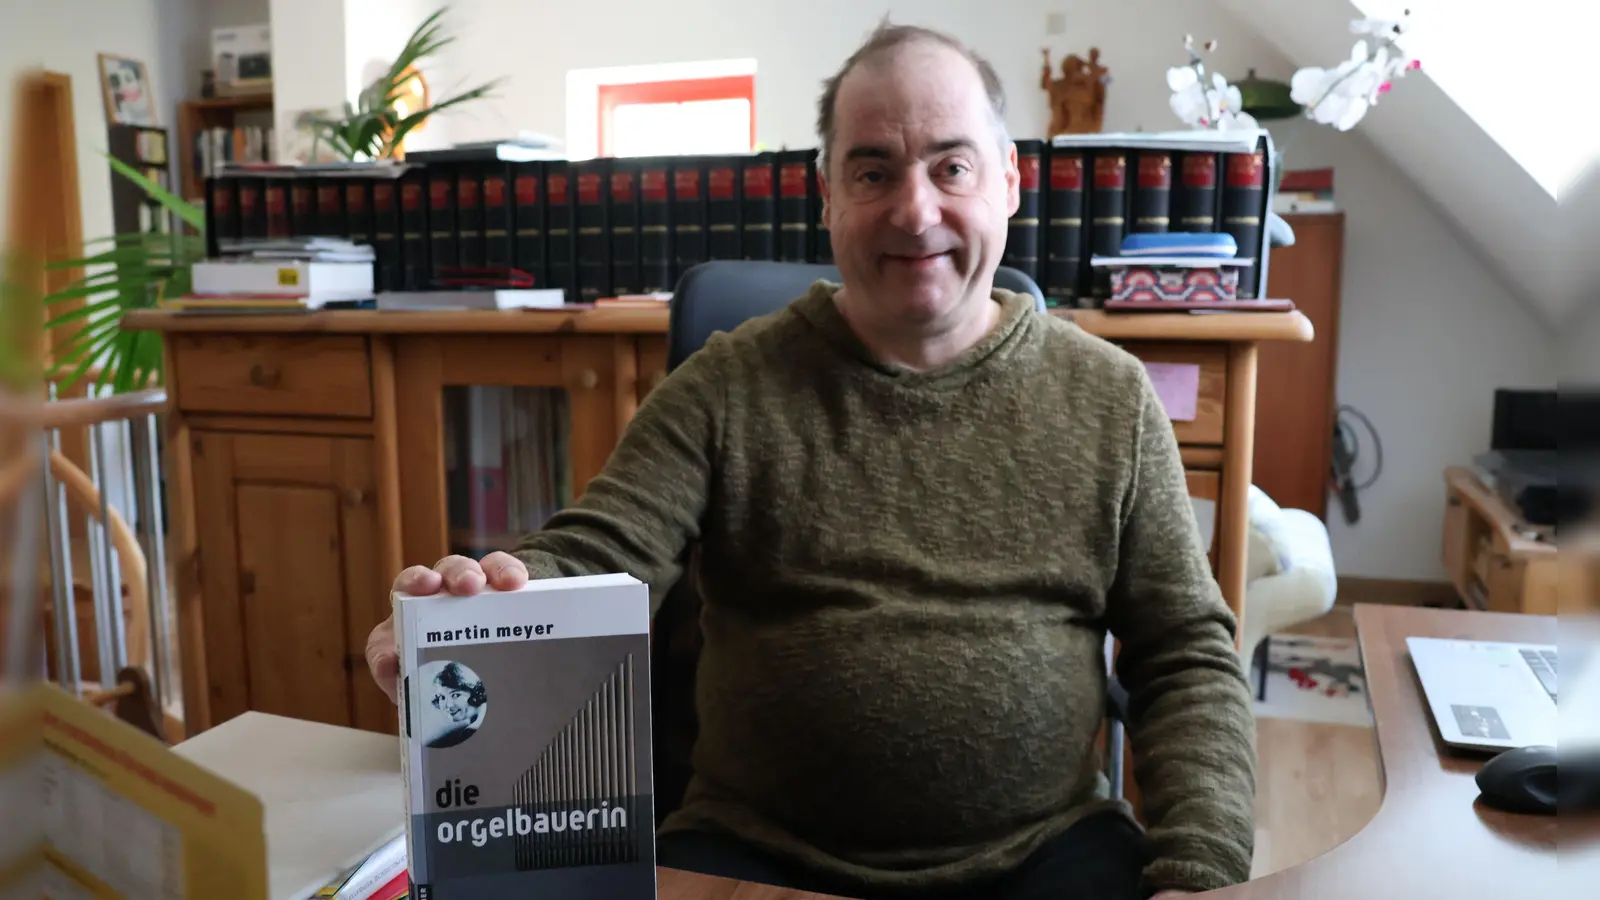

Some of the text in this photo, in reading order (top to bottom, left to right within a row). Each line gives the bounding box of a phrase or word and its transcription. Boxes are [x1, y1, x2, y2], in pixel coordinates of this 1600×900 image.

[427, 622, 554, 642] martin meyer
[435, 779, 480, 808] die
[437, 801, 627, 847] orgelbauerin
